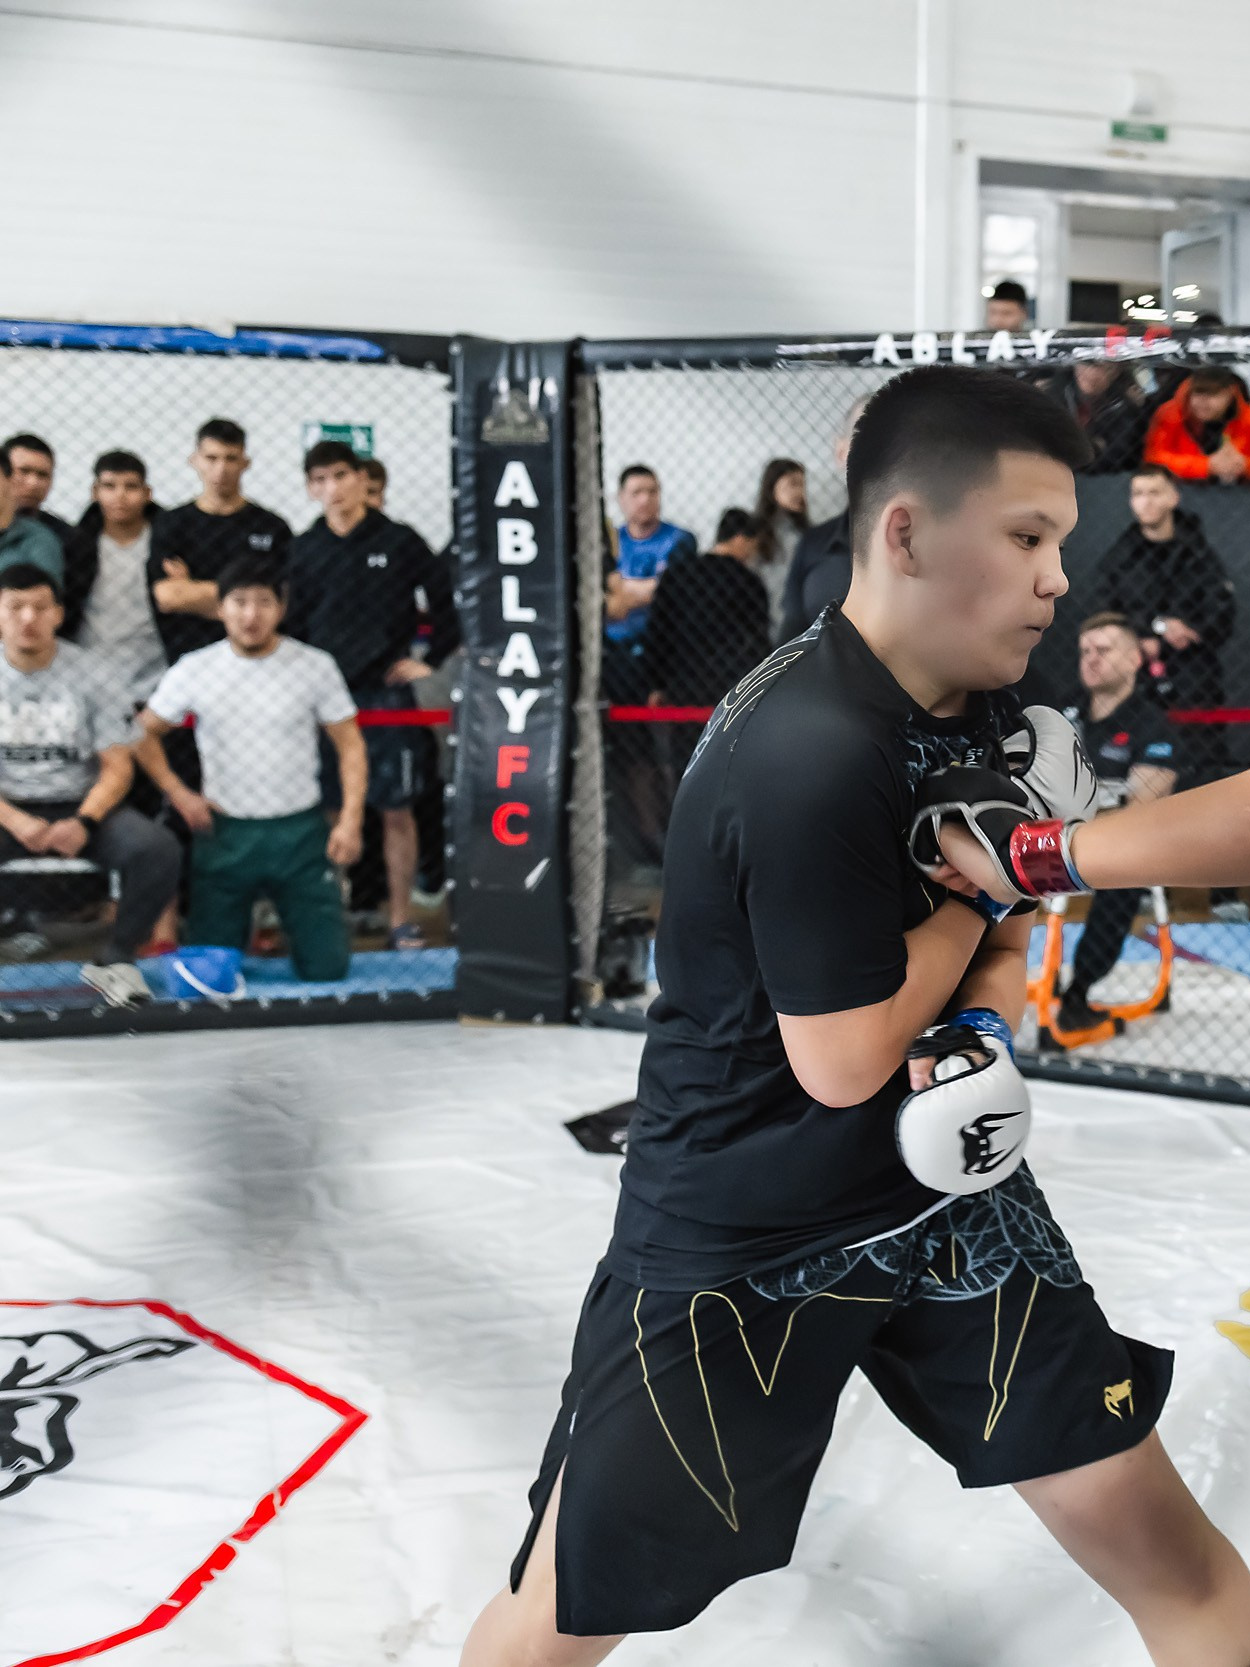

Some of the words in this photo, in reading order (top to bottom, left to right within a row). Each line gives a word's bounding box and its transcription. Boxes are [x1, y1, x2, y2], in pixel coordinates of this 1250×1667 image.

[871, 328, 1057, 365] ABLAY
[494, 460, 540, 735] ABLAY
[491, 745, 531, 846] FC
